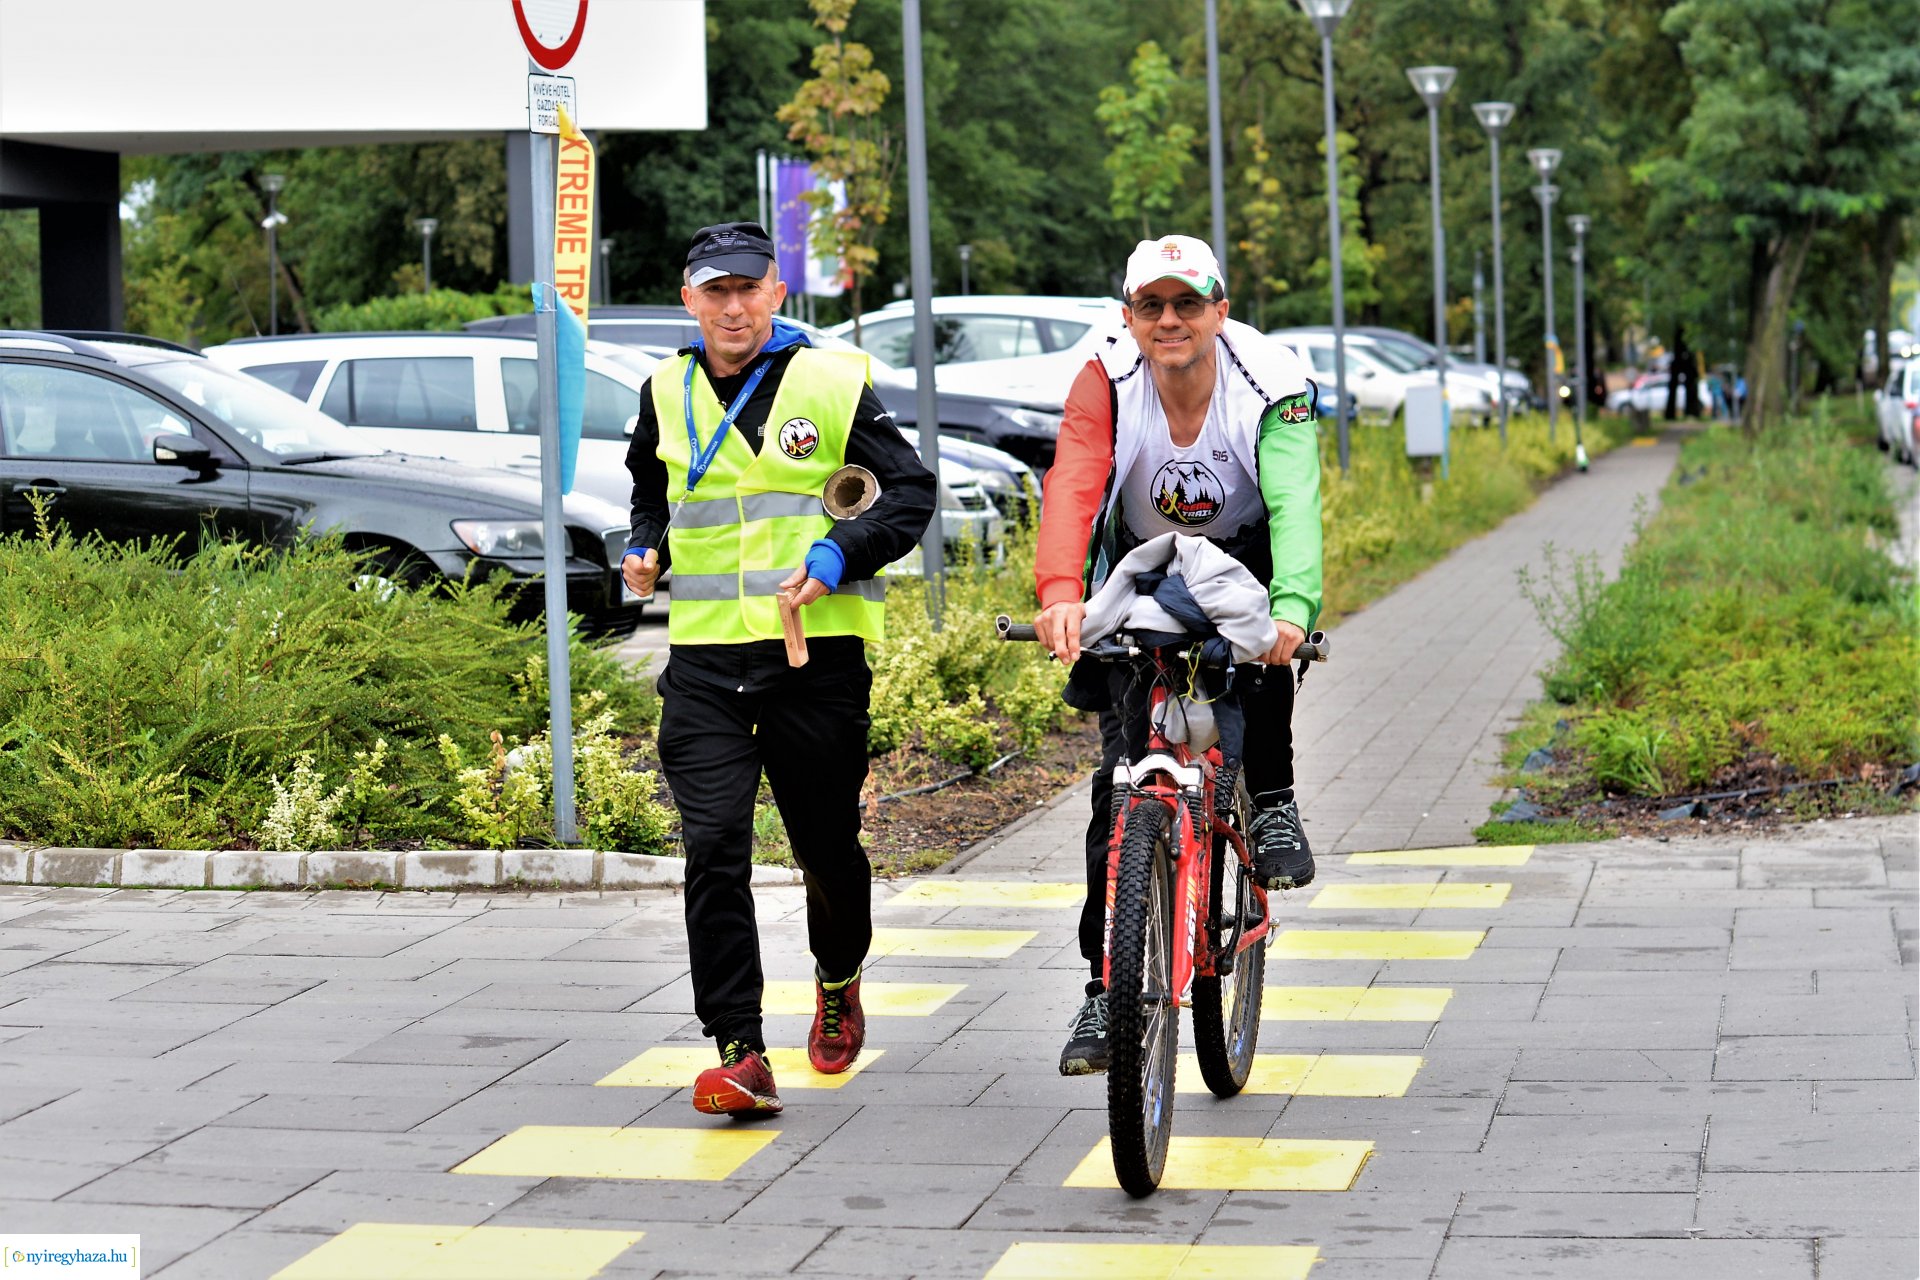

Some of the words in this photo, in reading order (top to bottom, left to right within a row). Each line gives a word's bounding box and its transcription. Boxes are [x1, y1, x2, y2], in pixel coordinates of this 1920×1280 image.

[533, 81, 552, 96] KIVÉVE
[553, 85, 570, 98] HOTEL
[538, 114, 560, 127] FORGAL
[557, 137, 590, 254] XTREME
[1187, 901, 1197, 958] RST
